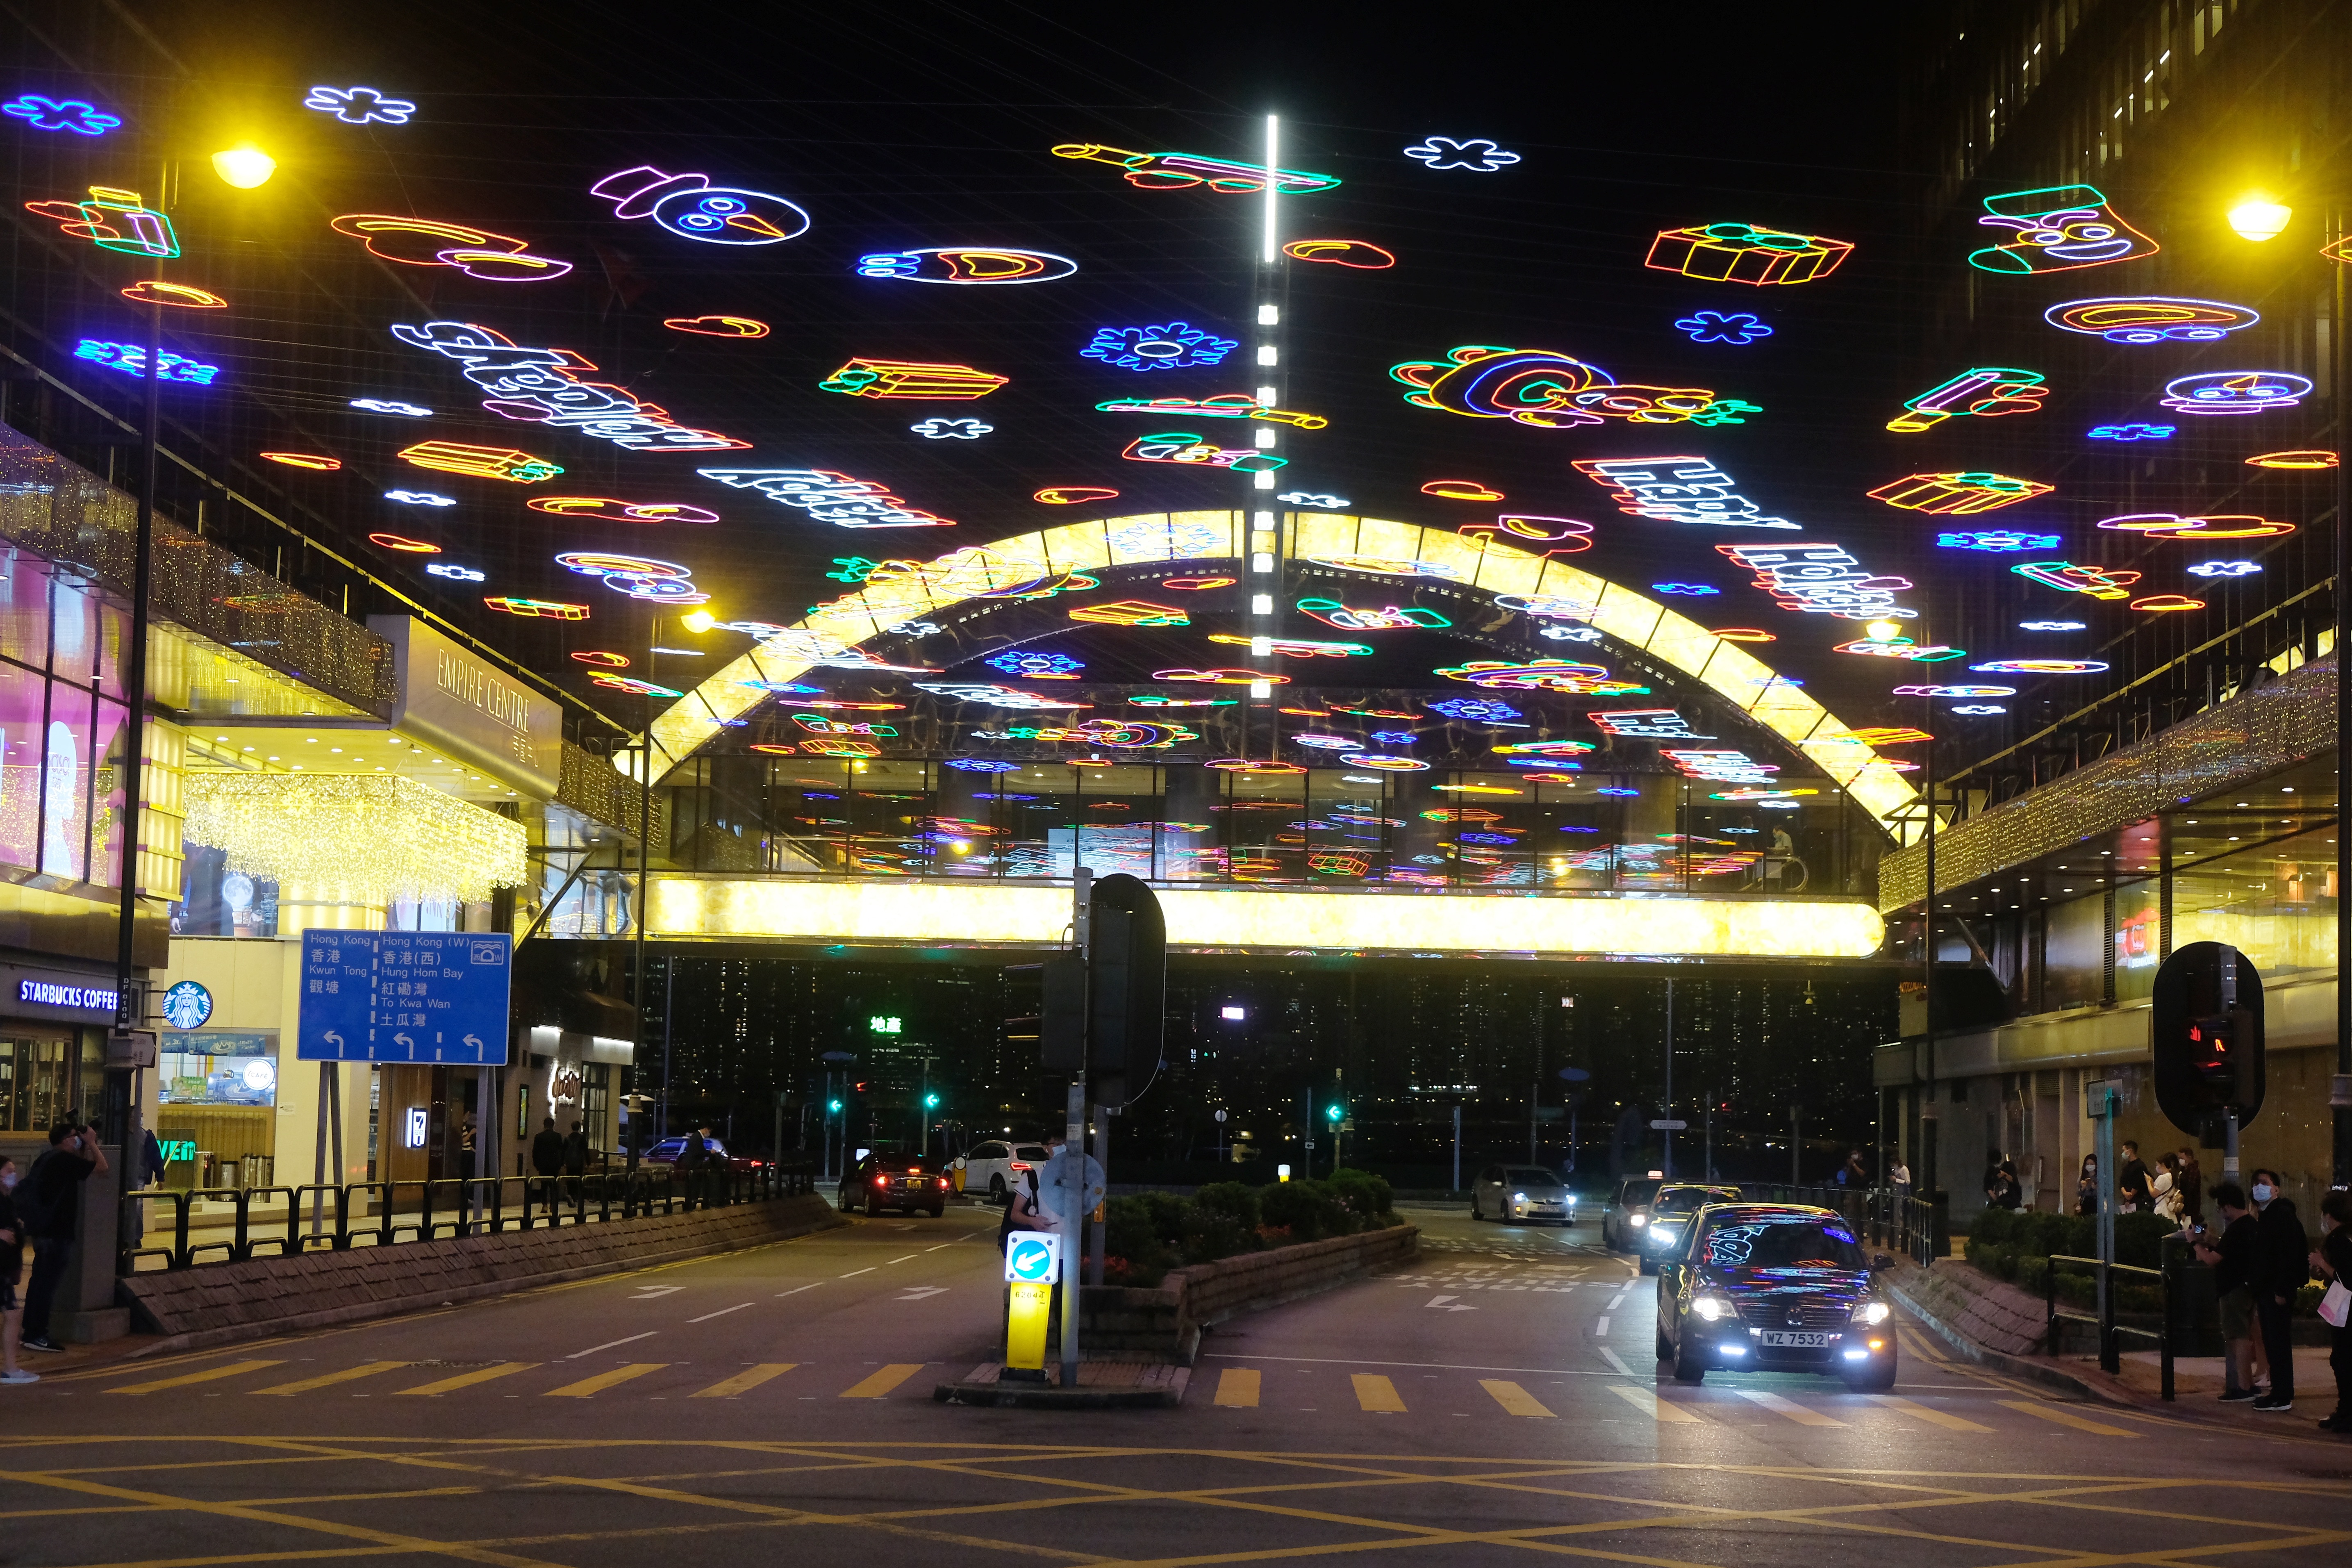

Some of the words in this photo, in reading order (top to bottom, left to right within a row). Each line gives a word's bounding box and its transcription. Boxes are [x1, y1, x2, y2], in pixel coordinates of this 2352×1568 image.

[437, 648, 483, 708] EMPIRE
[487, 678, 529, 733] CENTRE
[48, 748, 70, 776] asa
[311, 934, 338, 945] Hong
[343, 935, 370, 947] Kong
[382, 936, 410, 947] Hong
[416, 937, 442, 947] Kong
[448, 937, 469, 947] (W)
[311, 949, 340, 963] 香港
[382, 951, 441, 965] 香港(西)
[309, 965, 335, 974] Kwun
[343, 967, 367, 978] Tong
[382, 967, 408, 979] Hung
[414, 968, 438, 978] Hom
[444, 969, 463, 980] Bay
[123, 978, 129, 990] DF
[309, 979, 339, 994] 觀塘
[381, 982, 427, 996] 紅磡灣
[22, 980, 82, 1007] STARBUCKS
[83, 989, 118, 1010] COFFEE
[381, 998, 394, 1007] To
[400, 999, 422, 1008] Kwa
[428, 999, 450, 1009] Wan
[380, 1013, 426, 1027] 土瓜灣
[870, 1016, 901, 1033] 地產
[1396, 1282, 1574, 1293] MODY
[1767, 1333, 1783, 1344] WZ
[1788, 1334, 1824, 1345] 7532
